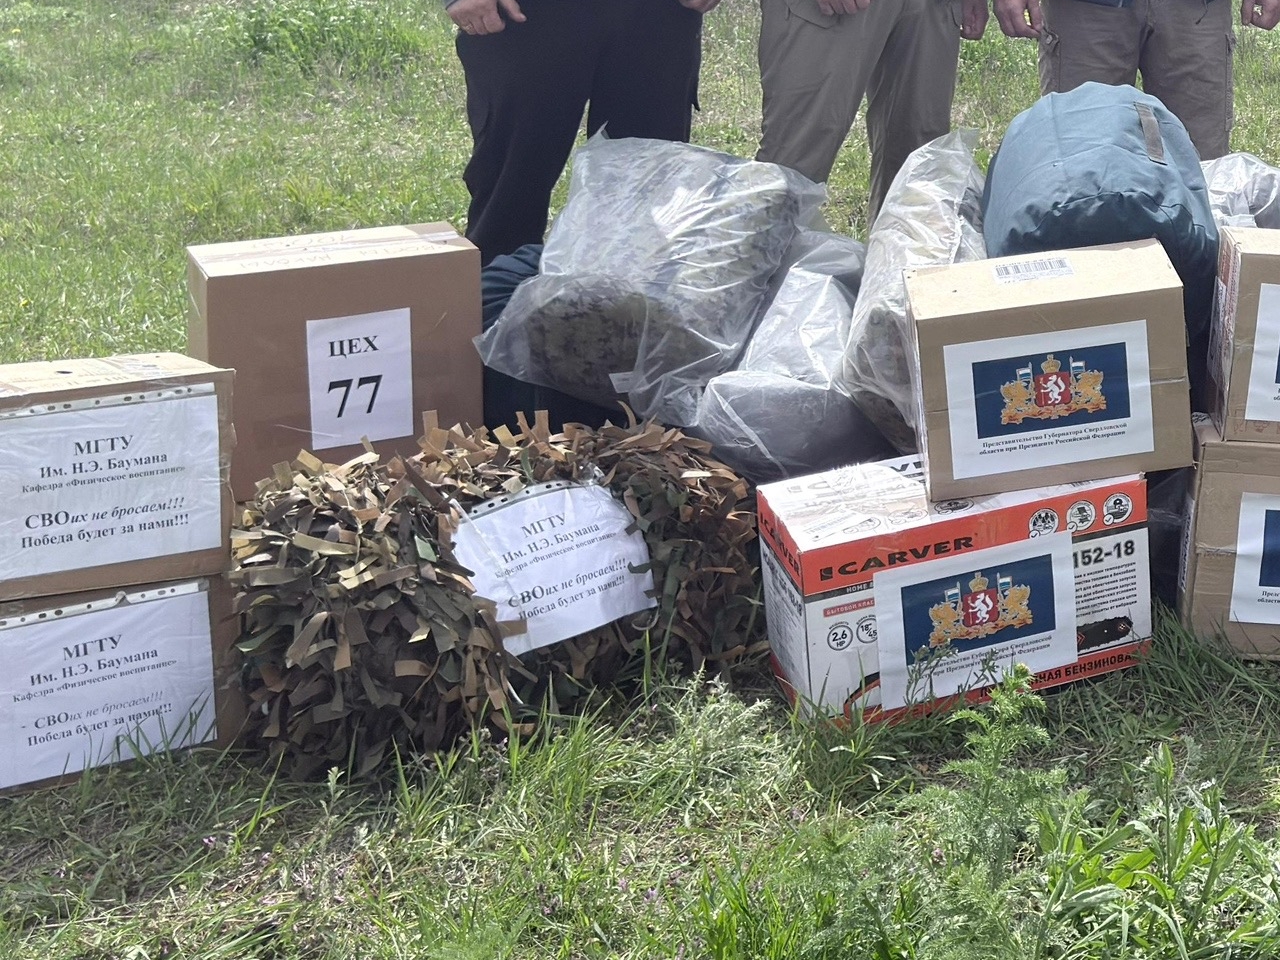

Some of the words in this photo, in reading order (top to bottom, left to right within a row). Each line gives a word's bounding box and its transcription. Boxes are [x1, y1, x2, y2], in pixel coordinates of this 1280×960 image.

[328, 335, 380, 358] ЦЕХ
[327, 374, 383, 418] 77
[74, 435, 134, 456] МГТУ
[979, 447, 1004, 455] области
[1005, 446, 1017, 454] при
[1018, 441, 1054, 451] Президенте
[1055, 435, 1090, 445] Российской
[1091, 430, 1126, 440] Федерации
[982, 435, 1043, 448] Представительство
[1044, 429, 1083, 441] Губернатора
[1084, 422, 1127, 433] Свердловской
[40, 467, 67, 479] Им.
[72, 460, 103, 474] Н.Э.
[107, 453, 167, 471] Баумана
[22, 481, 63, 494] Кафедра
[66, 474, 126, 488] «Физическое
[25, 511, 88, 529] СВОих
[91, 509, 108, 521] не
[111, 497, 185, 519] бросаем!!!
[521, 513, 568, 538] МГТУ
[21, 533, 73, 549] Победа
[77, 528, 116, 542] будет
[120, 525, 134, 534] за
[139, 513, 189, 531] нами!!!
[502, 550, 526, 565] Им.
[528, 539, 554, 554] Н.Э.
[555, 523, 600, 545] Баумана
[838, 536, 974, 575] CARVER
[508, 583, 559, 608] СВОих
[561, 578, 573, 591] не
[575, 558, 627, 585] бросаем!!!
[847, 583, 867, 593] HOME
[519, 602, 556, 620] Победа
[558, 593, 585, 610] будет
[587, 589, 596, 598] за
[598, 575, 625, 594] нами!!!
[826, 604, 857, 615] БЫТОВОЙ
[63, 634, 122, 661] МГТУ
[832, 630, 847, 642] 2.6
[30, 674, 57, 686] Им.
[62, 663, 93, 679] Н.Э.
[97, 648, 158, 670] Баумана
[1065, 654, 1134, 677] БЕНЗИНОВА
[13, 687, 54, 703] Кафедра
[56, 673, 117, 692] «Физическое
[34, 712, 82, 729] СВОих
[85, 707, 99, 718] не
[102, 691, 163, 714] бросаем!!!
[28, 731, 72, 747] Победа
[75, 719, 109, 735] будет
[112, 716, 125, 726] за
